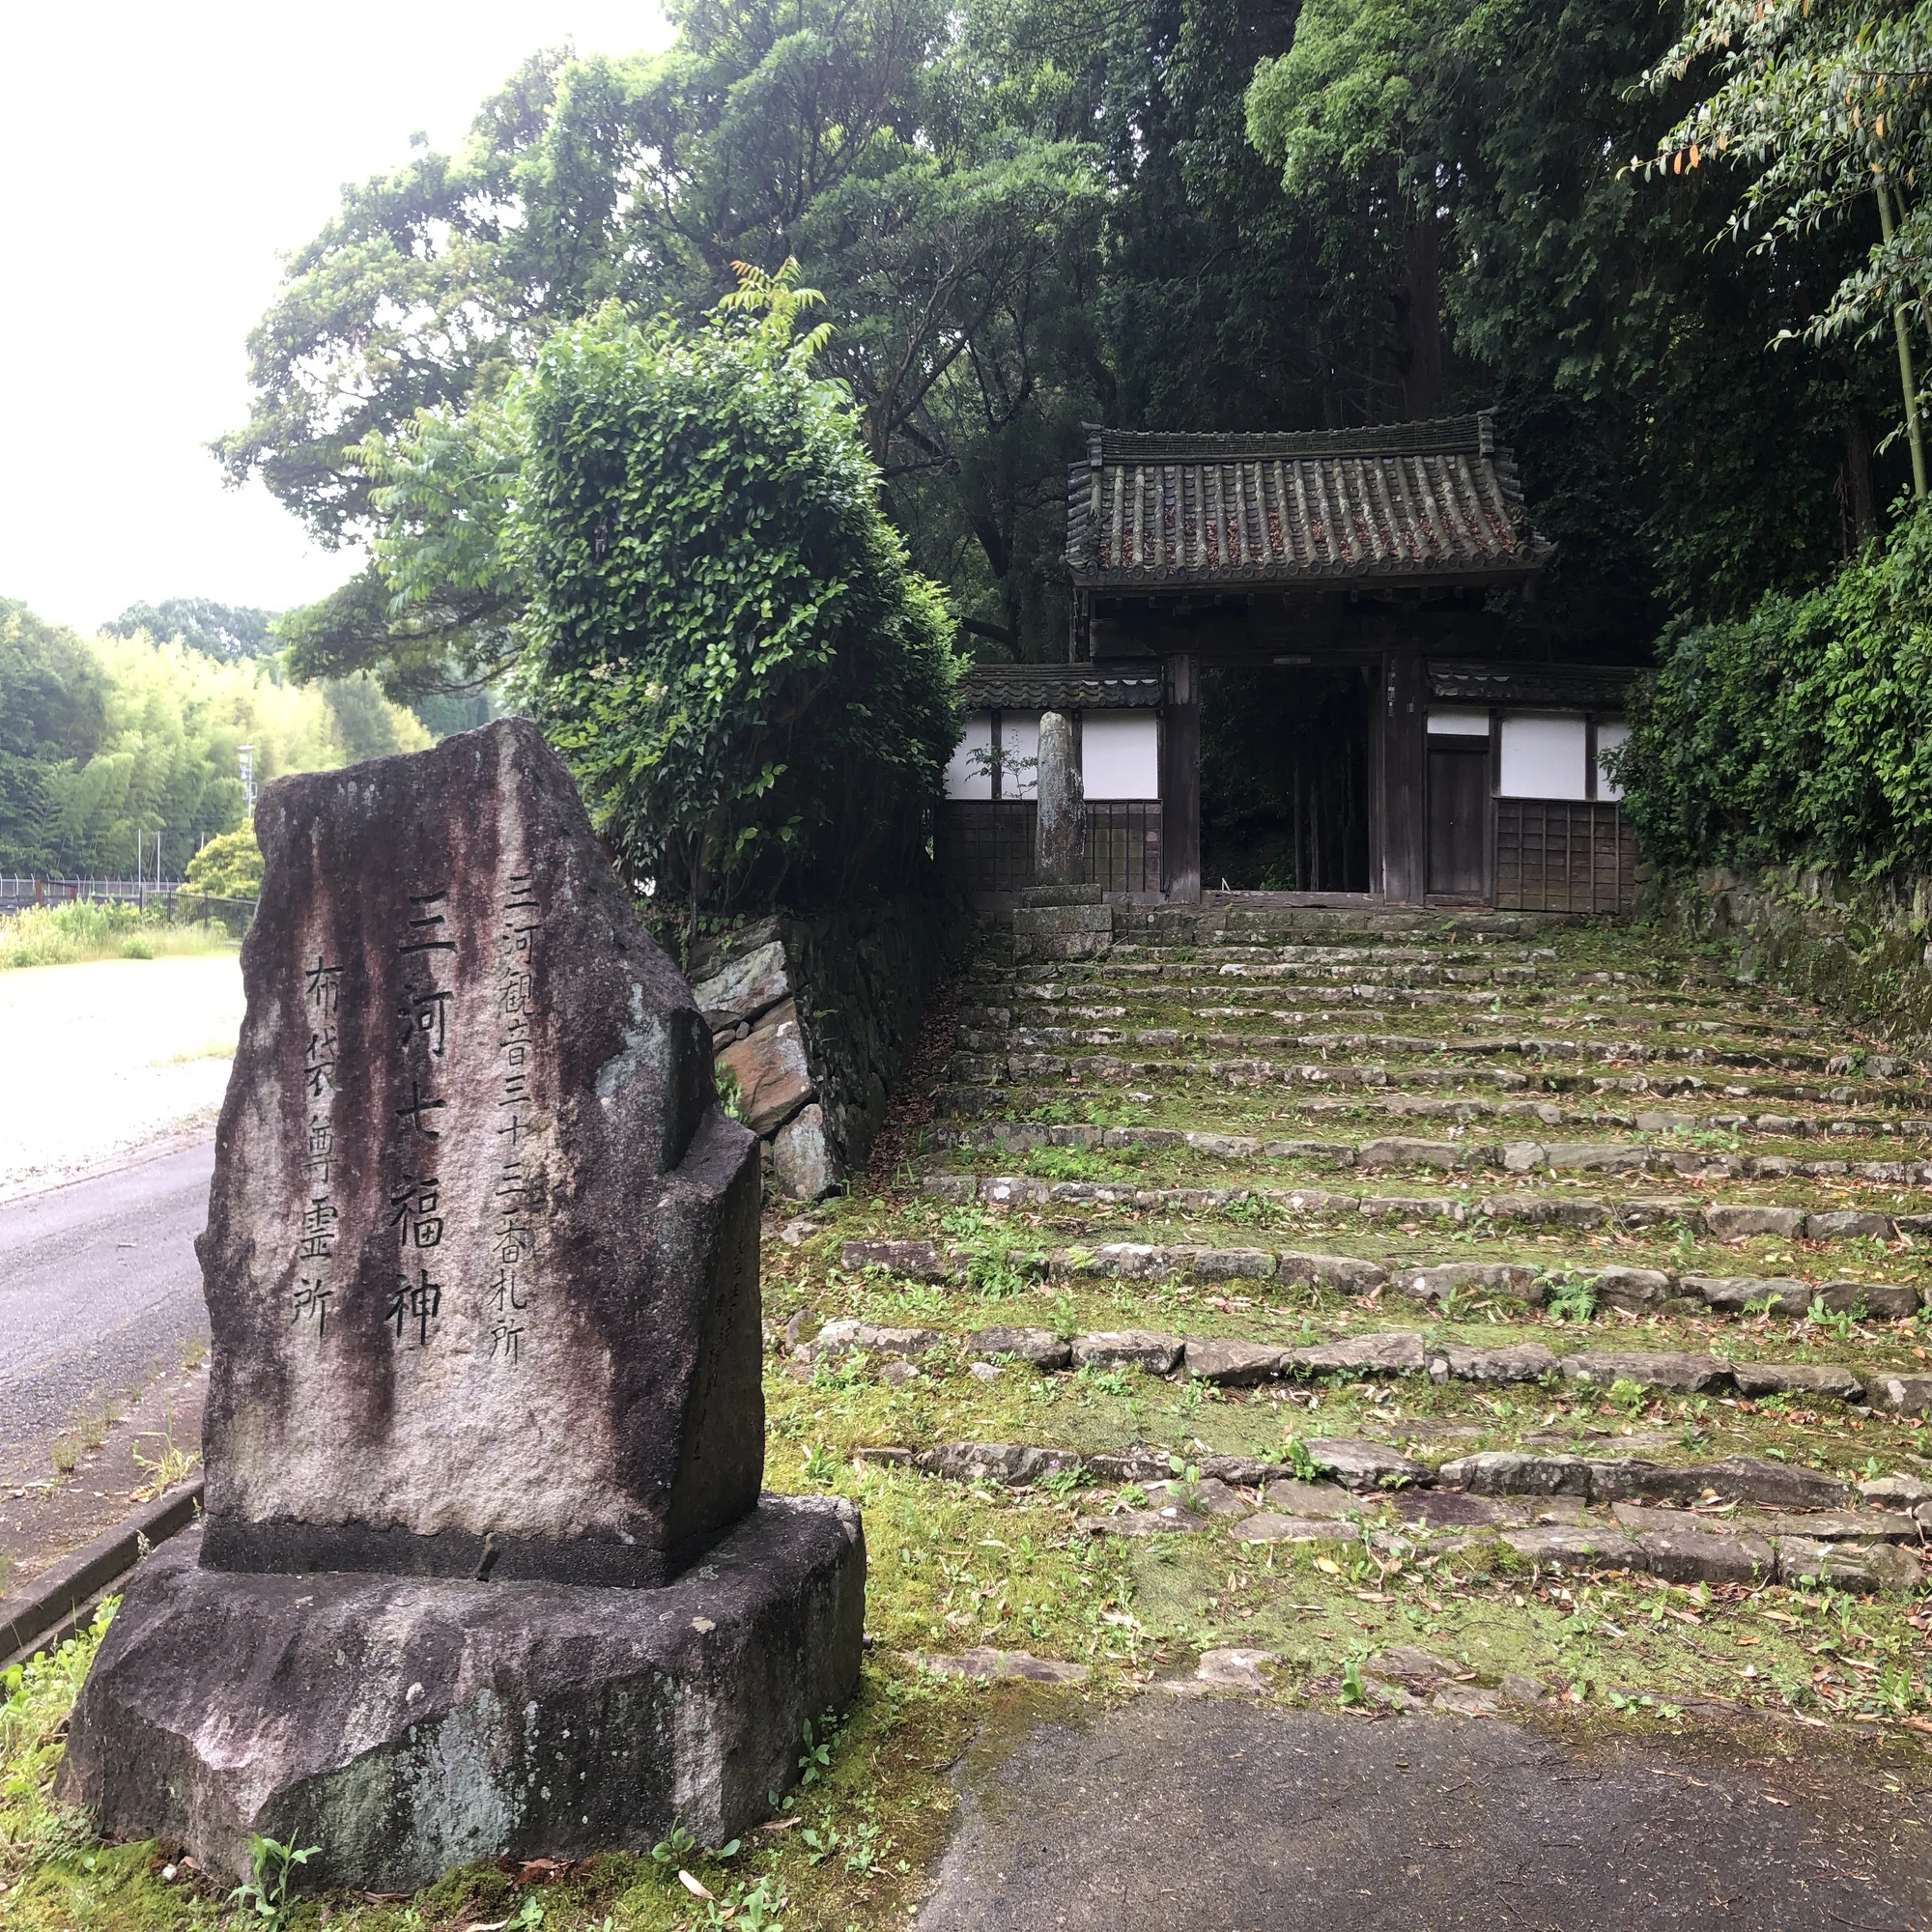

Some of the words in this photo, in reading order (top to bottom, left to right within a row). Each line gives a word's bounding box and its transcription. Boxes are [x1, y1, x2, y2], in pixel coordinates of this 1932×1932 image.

[290, 954, 345, 1339] 布袋尊霊所
[386, 890, 459, 1348] 三河七福神
[489, 871, 543, 1366] 三河観音三十三番札所
